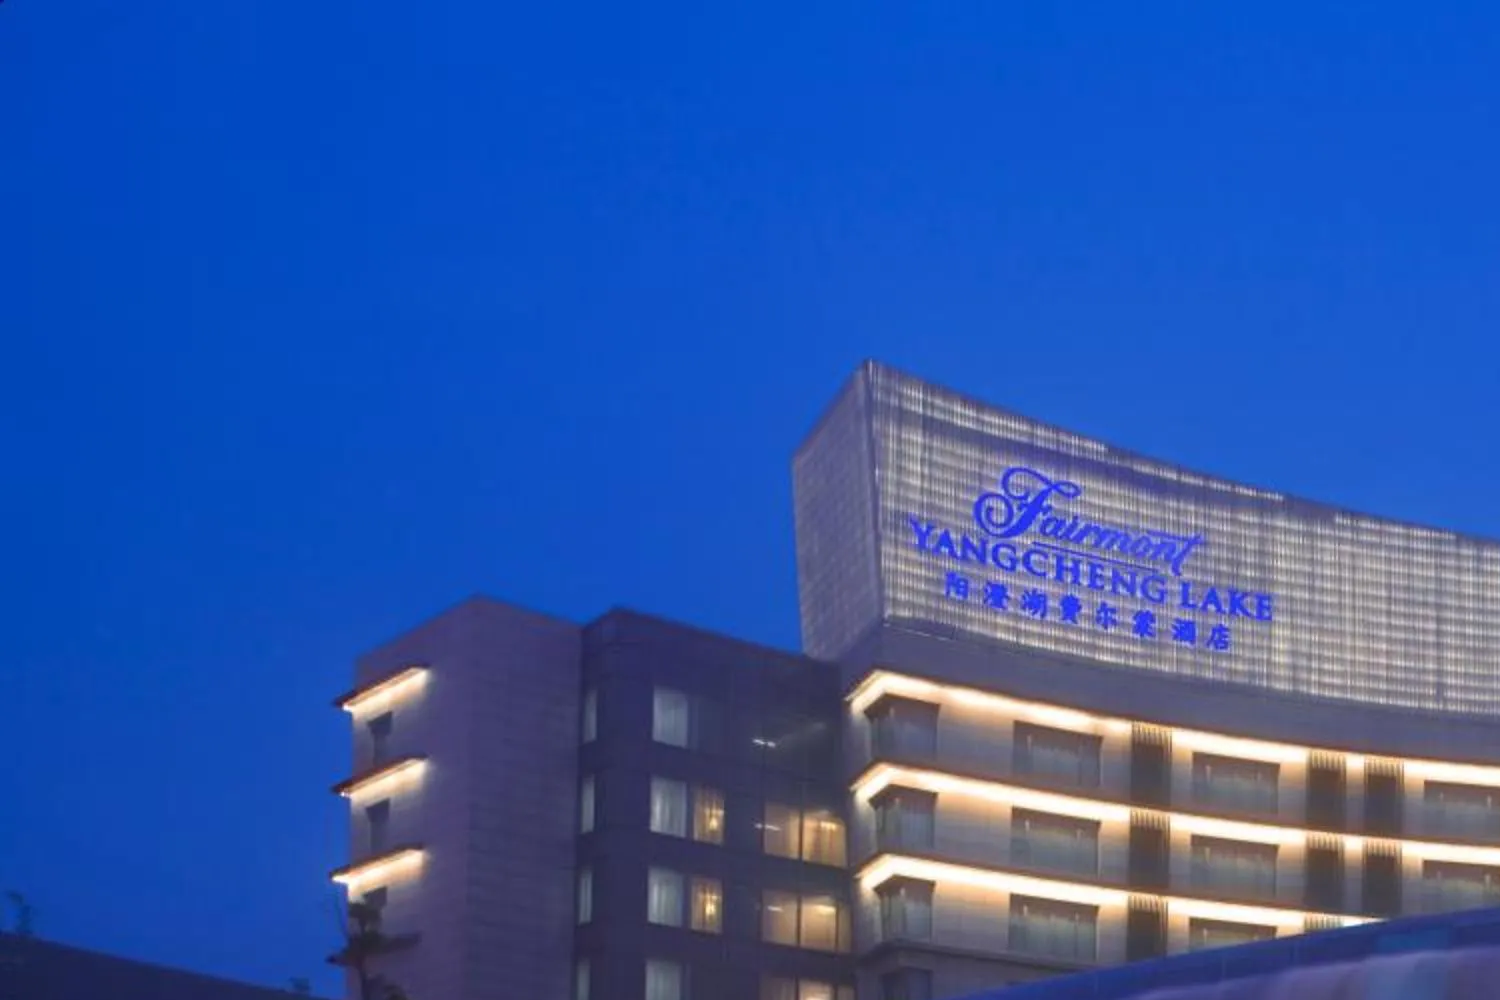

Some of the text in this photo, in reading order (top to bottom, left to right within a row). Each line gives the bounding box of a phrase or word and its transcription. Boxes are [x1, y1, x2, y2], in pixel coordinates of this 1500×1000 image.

[907, 514, 1273, 622] YANGCHENG LAKE
[972, 466, 1205, 576] Fairmont
